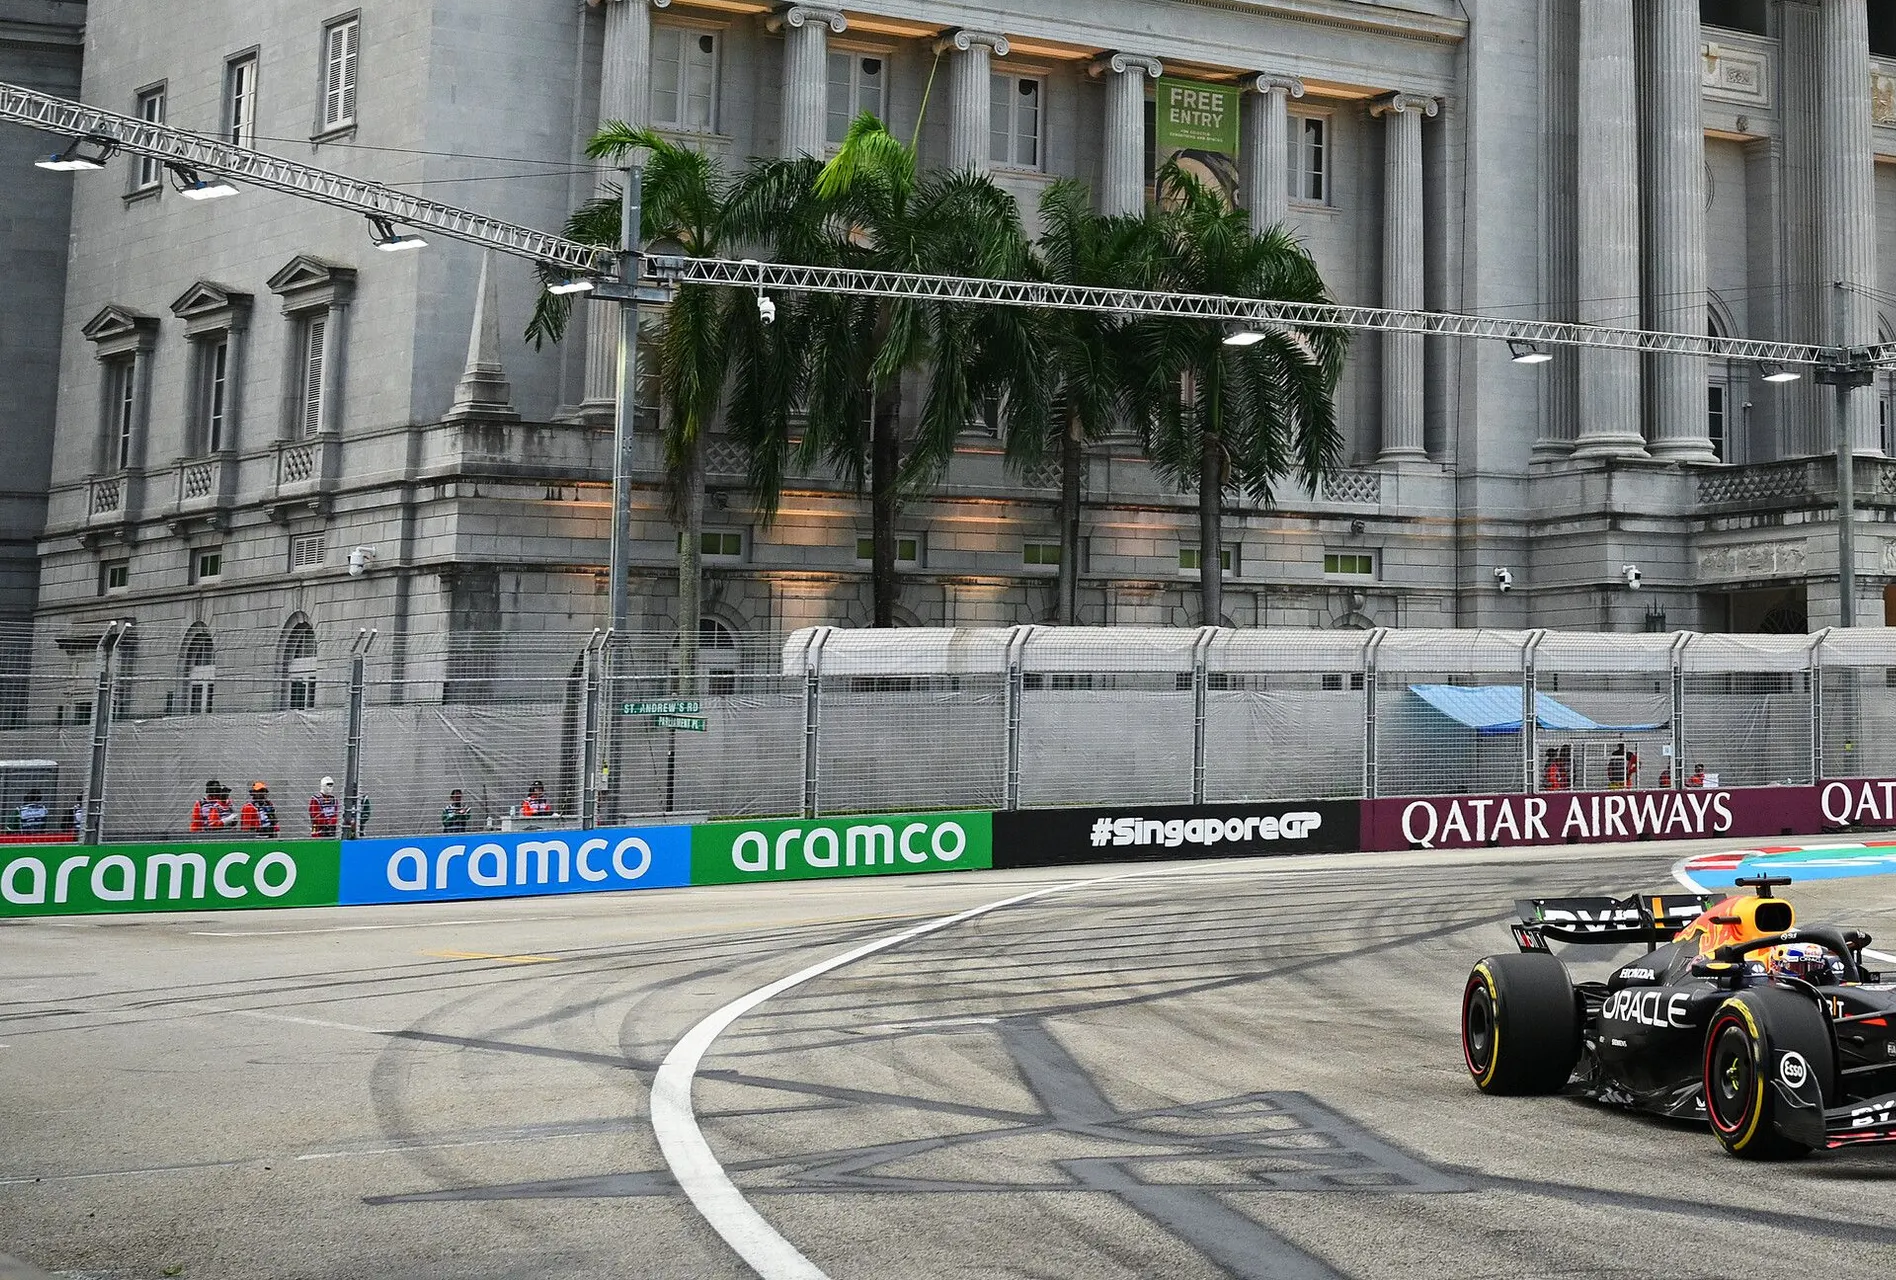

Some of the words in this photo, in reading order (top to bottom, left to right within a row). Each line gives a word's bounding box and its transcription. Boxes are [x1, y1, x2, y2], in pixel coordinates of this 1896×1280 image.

[1169, 108, 1224, 129] ENTRY
[1170, 87, 1224, 113] FREE
[624, 703, 637, 714] ST.
[640, 702, 685, 714] ANDREW'S
[687, 702, 699, 712] RD
[1090, 811, 1322, 847] #SingaporeGP
[1401, 797, 1550, 849] QATAR
[1561, 791, 1733, 838] AIRWAYS
[387, 837, 652, 891] aramco
[731, 821, 966, 872] aramco
[1, 851, 297, 904] aramco
[1619, 968, 1656, 980] HONDA
[1602, 990, 1697, 1029] ORACLE
